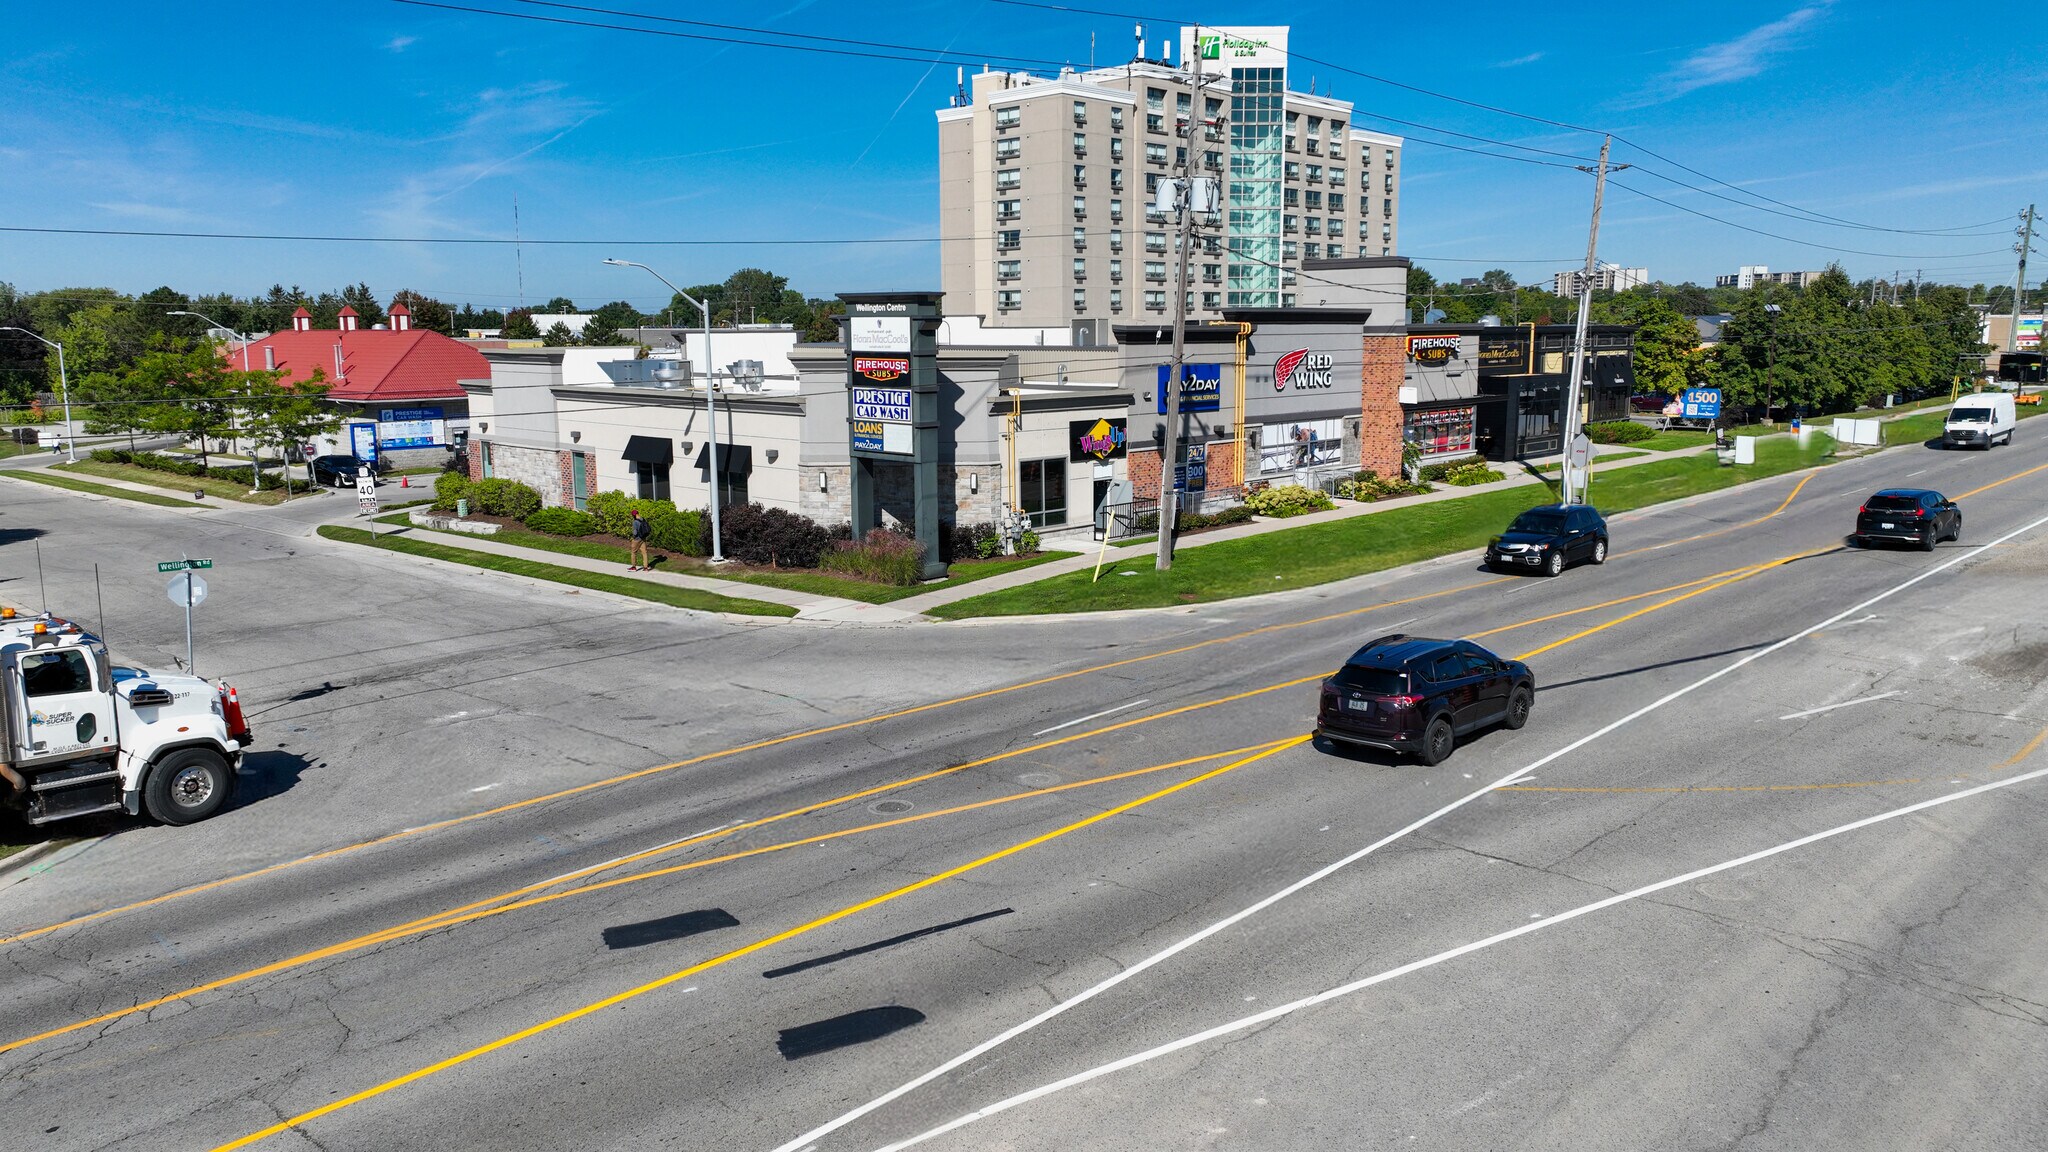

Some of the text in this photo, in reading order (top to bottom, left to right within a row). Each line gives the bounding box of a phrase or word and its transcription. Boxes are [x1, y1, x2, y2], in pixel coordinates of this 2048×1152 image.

[1223, 39, 1268, 50] Holiday Inn
[856, 303, 907, 313] Wellington Centre
[1412, 338, 1461, 354] FIREHOUSE
[1428, 349, 1446, 359] SUBS
[856, 360, 907, 373] FIREHOUSE
[1307, 354, 1333, 370] RED
[872, 370, 891, 378] SUBS
[1295, 371, 1333, 387] WING
[856, 391, 909, 406] PRESTIGE
[857, 405, 909, 420] CAR WASH
[853, 421, 883, 435] LOANS
[854, 439, 883, 450] PAY2DAY
[1188, 447, 1204, 457] 24/7
[360, 485, 374, 495] 40
[46, 716, 75, 725] SUCKER
[49, 711, 72, 720] SUPER
